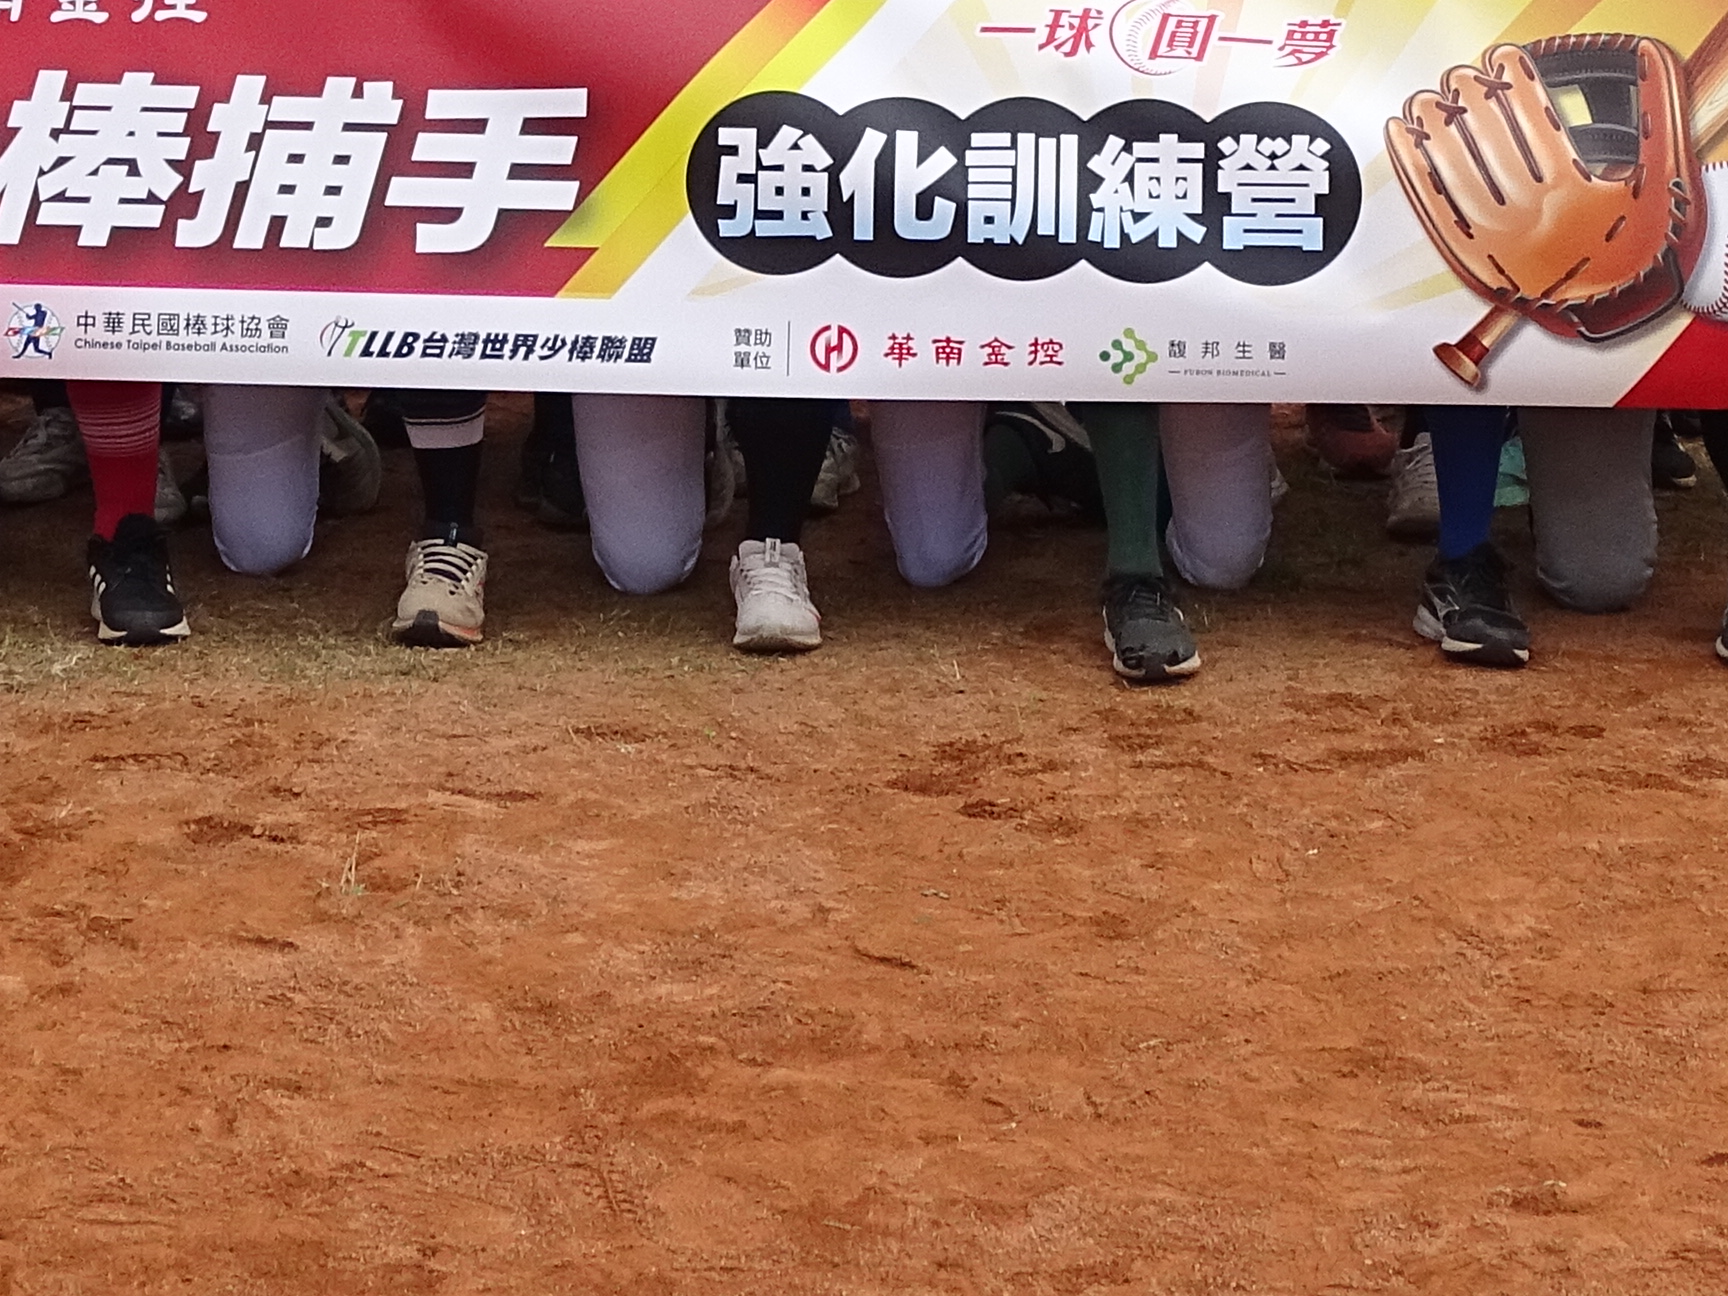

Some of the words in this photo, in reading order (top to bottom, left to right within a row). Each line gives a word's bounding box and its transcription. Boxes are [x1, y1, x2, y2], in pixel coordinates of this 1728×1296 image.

[979, 7, 1343, 68] 一球圓一夢
[716, 123, 1334, 253] 強化訓練營
[74, 310, 291, 341] 中華民國棒球協會
[74, 337, 123, 351] Chinese
[126, 338, 163, 354] Taipei
[165, 339, 217, 353] Baseball
[219, 340, 290, 355] Association
[733, 351, 773, 371] 單位
[883, 332, 1065, 368] 華南金控
[1168, 339, 1287, 361] 馥邦生醫
